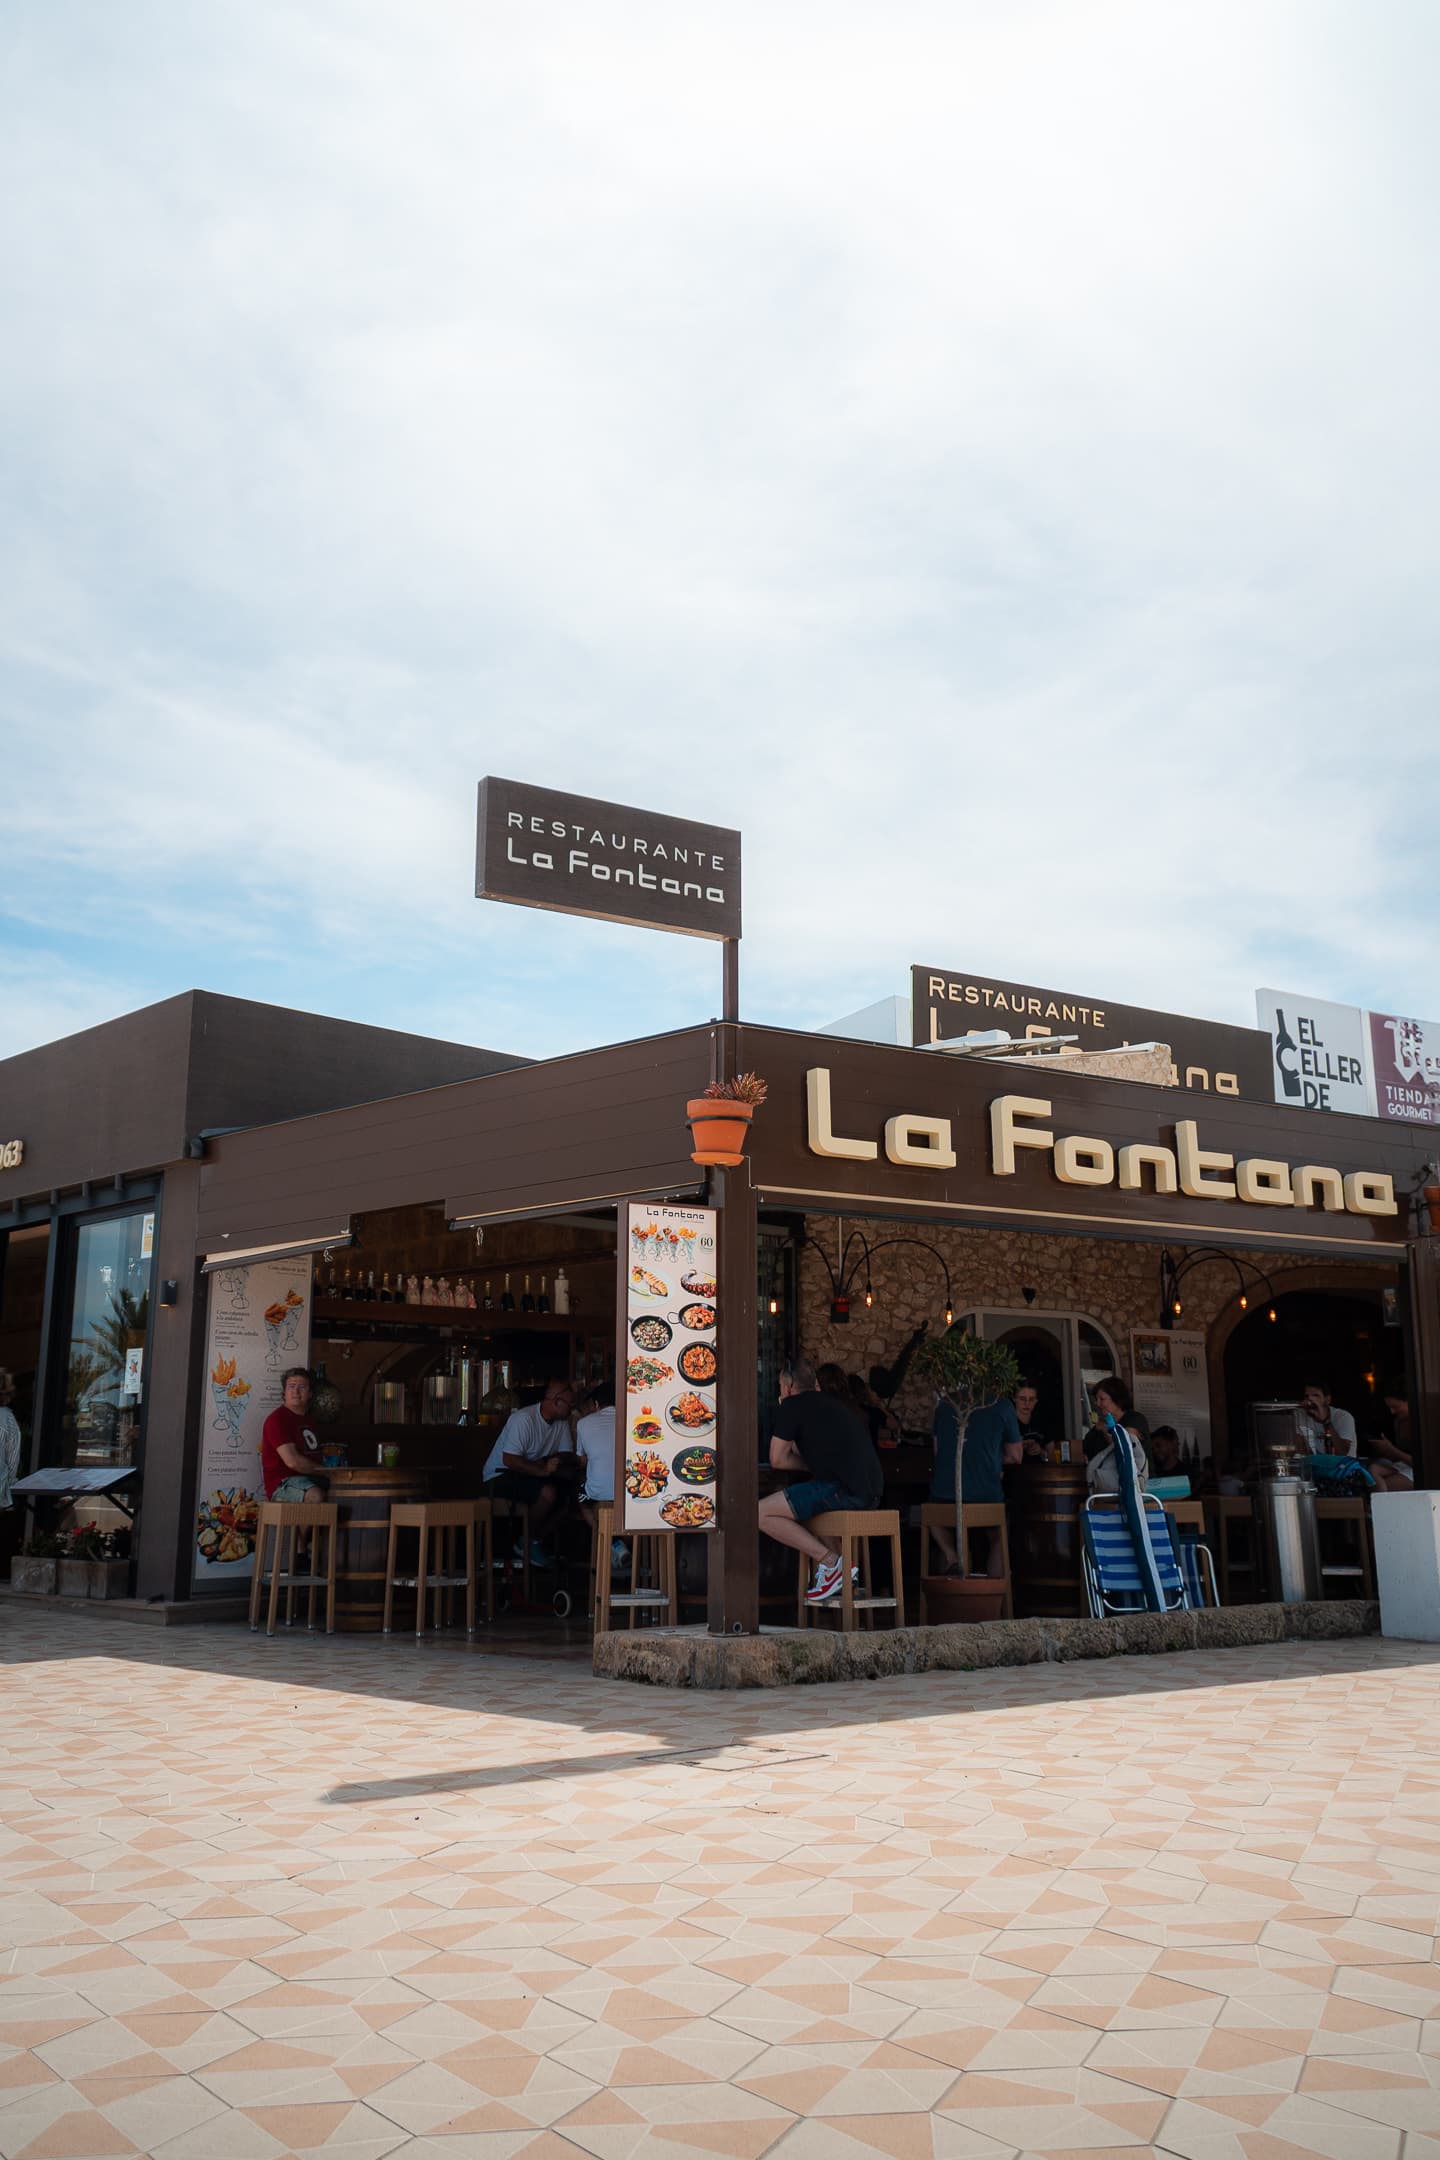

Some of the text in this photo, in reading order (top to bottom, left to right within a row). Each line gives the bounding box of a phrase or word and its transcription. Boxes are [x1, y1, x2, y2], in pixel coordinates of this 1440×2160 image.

[508, 811, 725, 871] RESTAURANTE
[507, 837, 725, 903] La Fontana
[929, 976, 1105, 1027] RESTAURANTE
[1298, 1017, 1323, 1047] EL
[1276, 1042, 1363, 1085] CELLER
[1303, 1081, 1331, 1111] DE
[1387, 1103, 1432, 1120] GOURMET
[806, 1067, 1398, 1216] La Fontana
[646, 1207, 705, 1220] La Fontana
[700, 1237, 713, 1247] 60
